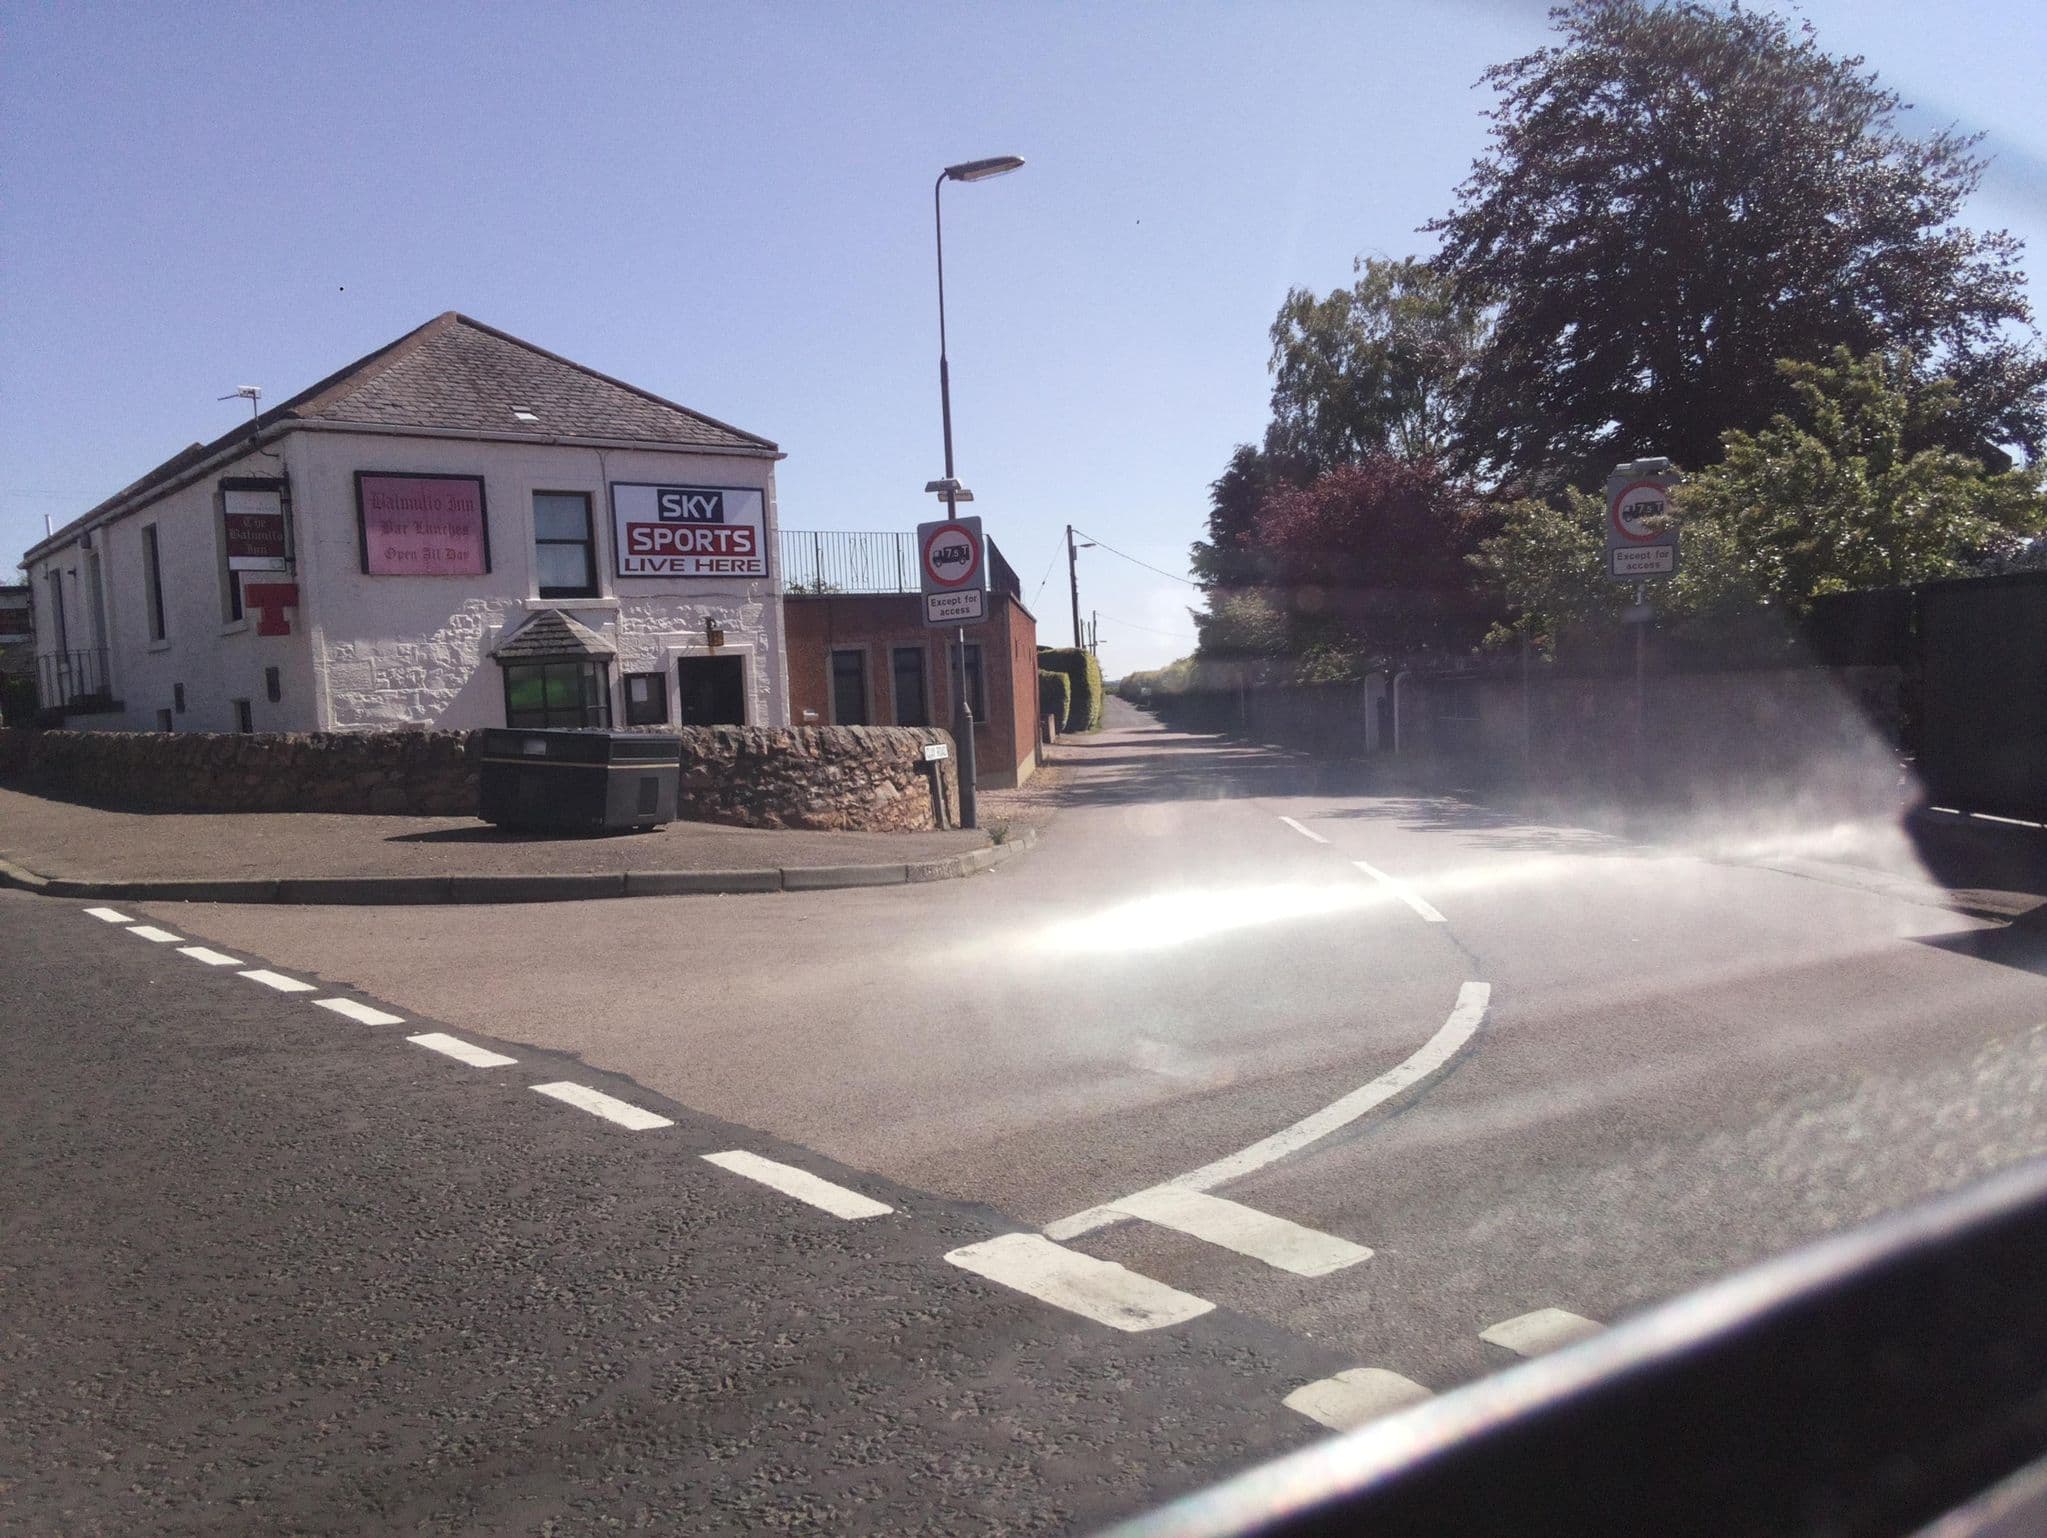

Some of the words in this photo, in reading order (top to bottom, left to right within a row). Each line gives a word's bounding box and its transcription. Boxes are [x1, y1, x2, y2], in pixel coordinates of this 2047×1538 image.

[446, 495, 474, 512] Inn
[662, 494, 718, 518] SKY
[381, 520, 408, 536] Bar
[413, 520, 469, 537] Lunches
[632, 527, 751, 552] SPORTS
[384, 547, 417, 561] Open
[423, 547, 441, 560] All
[445, 547, 470, 561] Day
[1617, 552, 1651, 561] Except
[1656, 550, 1669, 558] for
[624, 558, 685, 572] LIVE
[695, 559, 761, 572] HERE
[930, 596, 962, 607] Except
[965, 594, 977, 603] for
[940, 606, 970, 617] access
